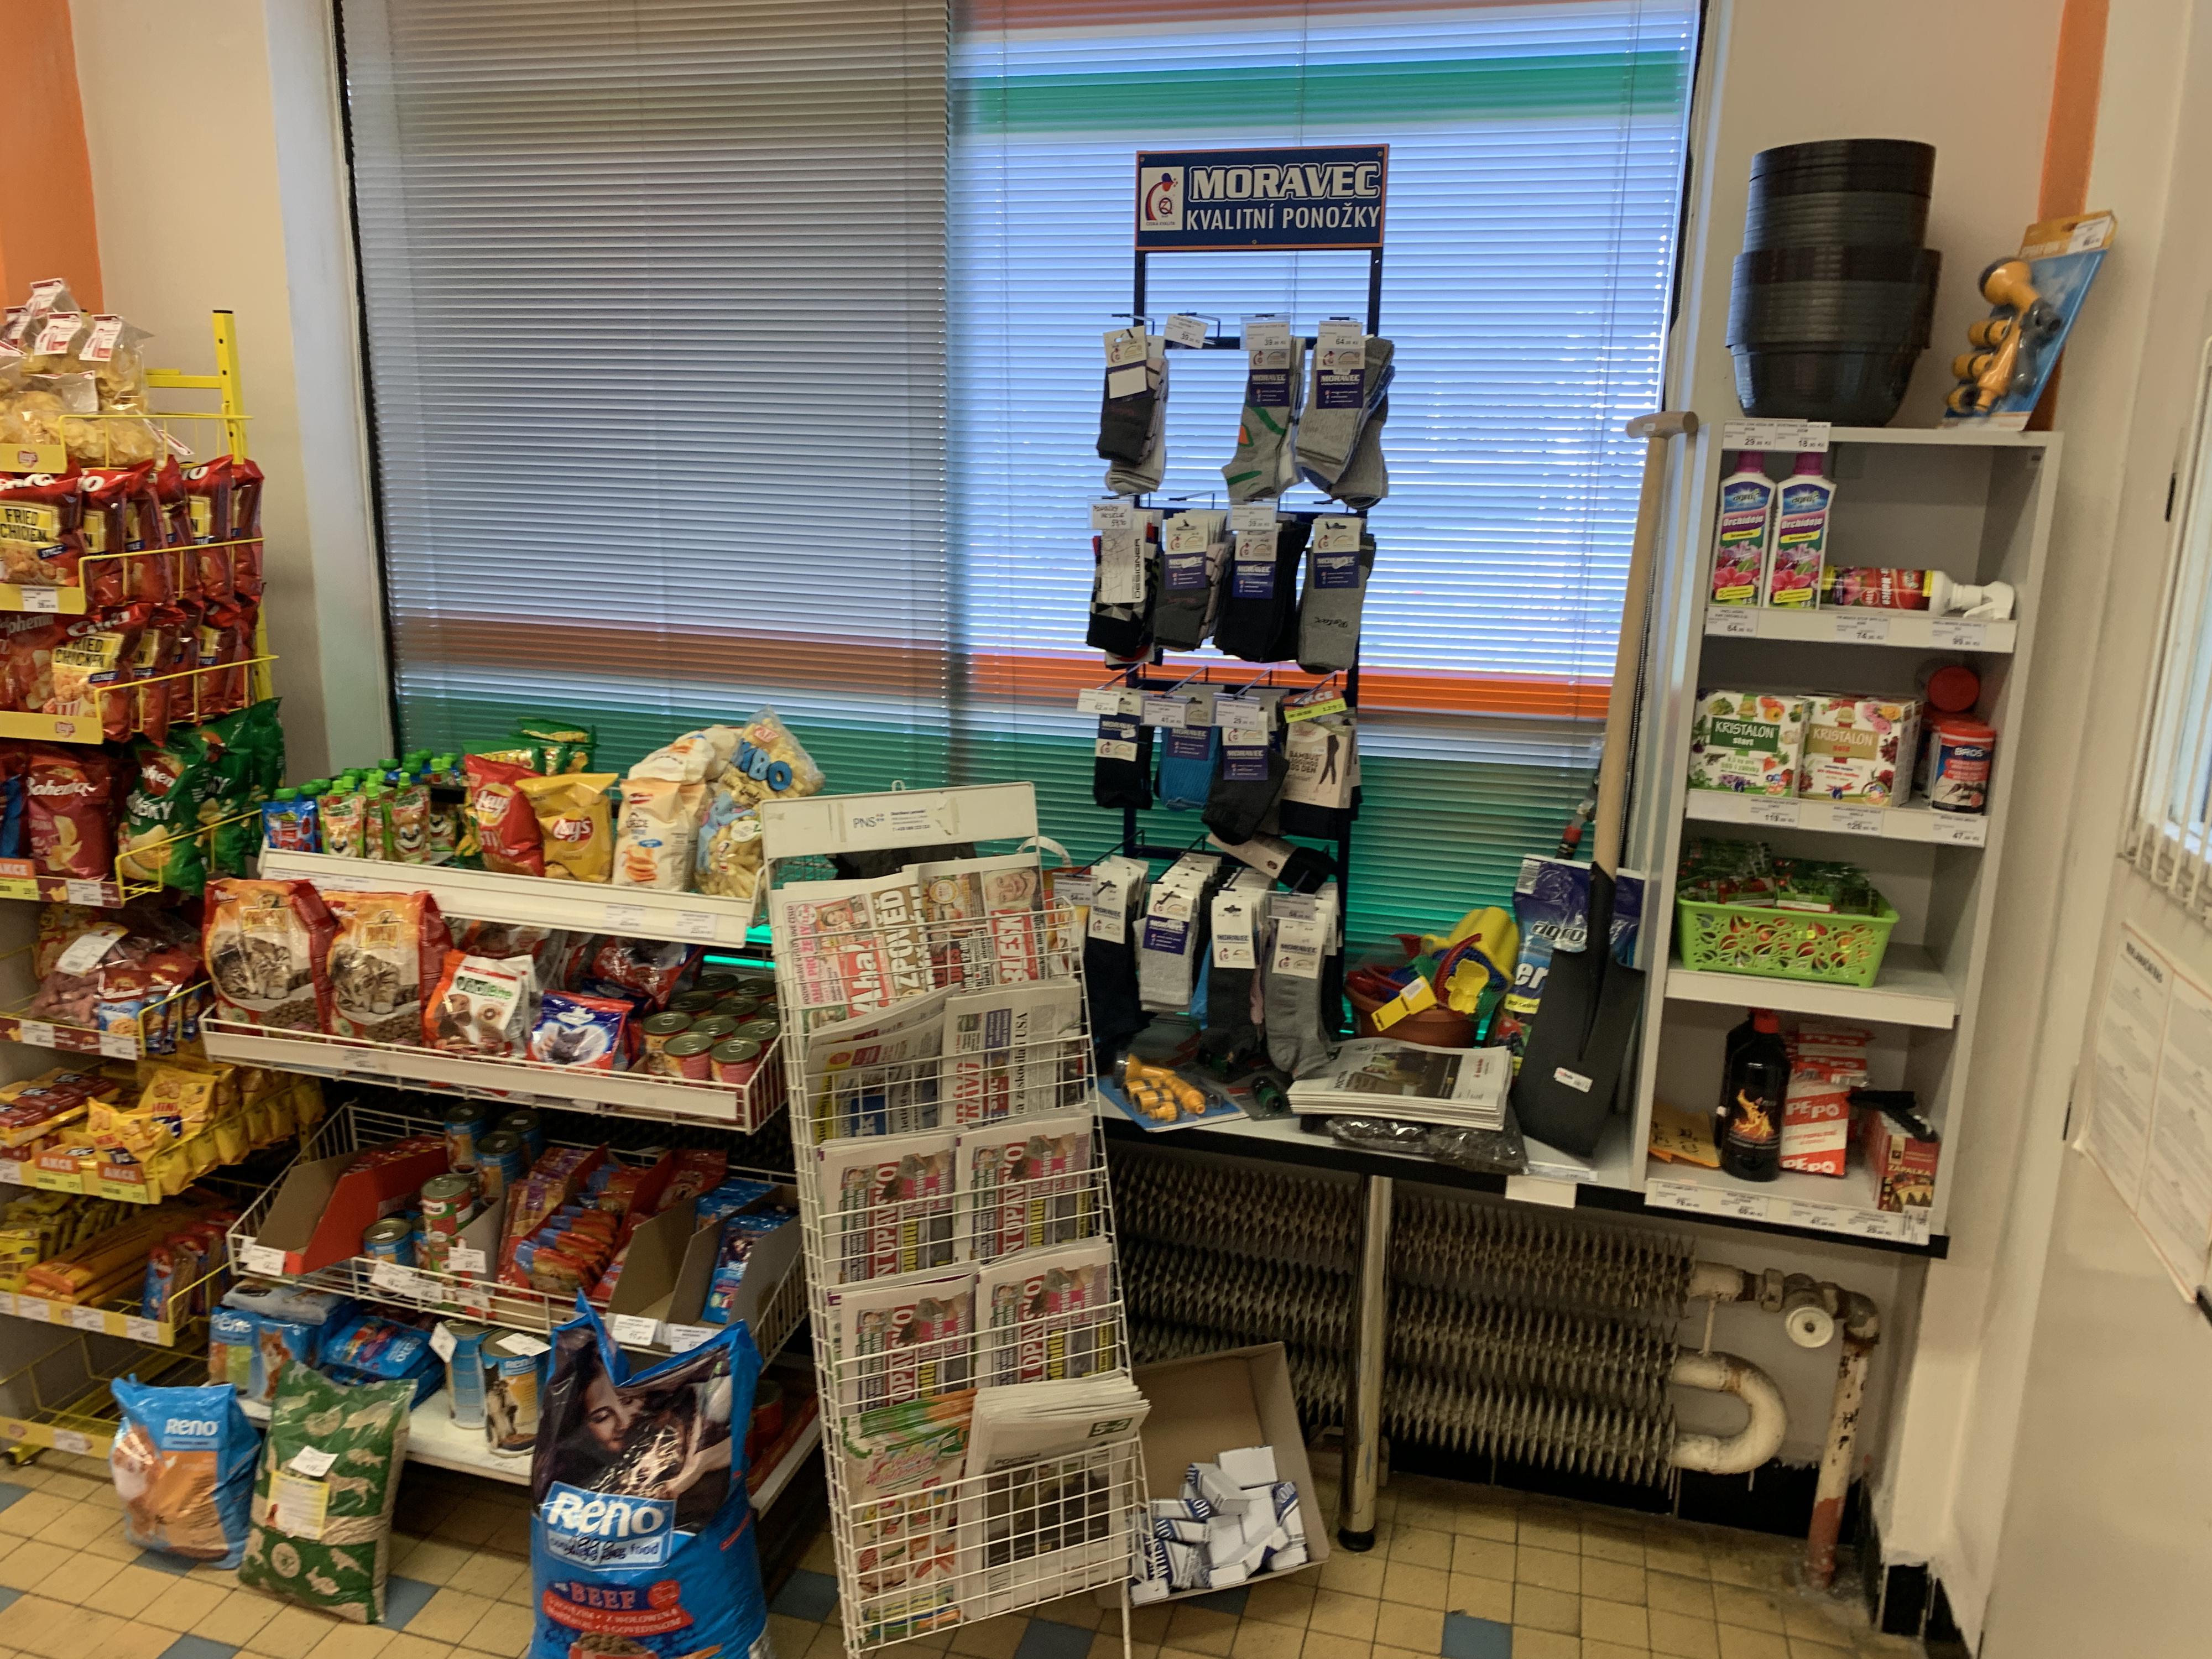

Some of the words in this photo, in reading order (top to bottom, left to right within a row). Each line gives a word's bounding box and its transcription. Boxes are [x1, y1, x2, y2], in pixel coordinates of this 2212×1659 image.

[1191, 164, 1379, 201] MORAVEC
[1186, 204, 1274, 230] KVALITNÍ
[1282, 202, 1380, 228] PONOŽKY
[6, 509, 38, 526] FRIED
[1317, 556, 1355, 564] MOREC
[1715, 720, 1775, 739] KRISTALON
[1812, 726, 1874, 747] KRISTALON
[853, 816, 877, 828] PNS
[874, 890, 922, 989] ZPOVĚĎ
[1532, 921, 1585, 943] agro
[995, 912, 1029, 983] BLESK
[838, 943, 884, 1013] Aha!
[1015, 1013, 1028, 1038] USA
[1786, 1101, 1840, 1119] PEPO
[1782, 1157, 1836, 1174] PEPO
[1004, 1146, 1025, 1236] OPAVO
[874, 1166, 897, 1258] OPAVO
[1022, 1280, 1043, 1370] OPAVO
[891, 1310, 914, 1400] OPAVO
[165, 1417, 219, 1437] Reno
[547, 1491, 665, 1538] Reno
[570, 1582, 636, 1610] BEEF
